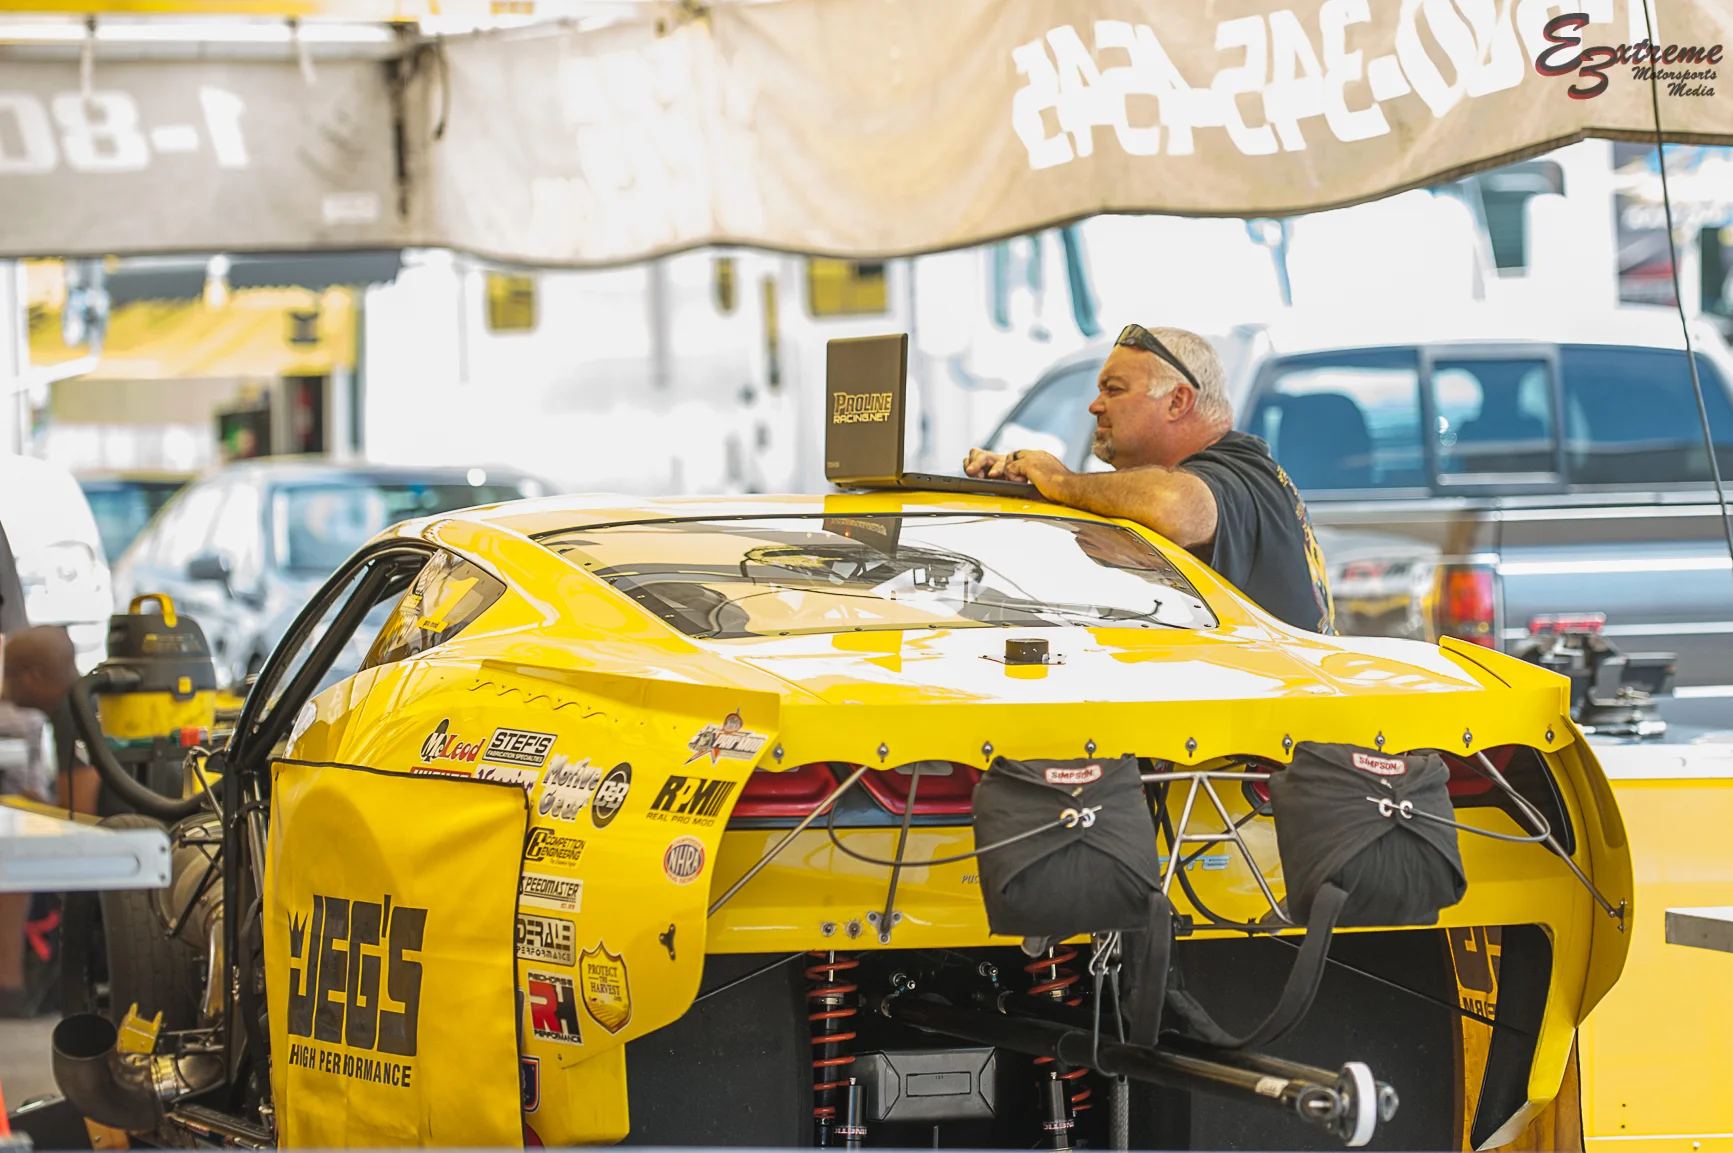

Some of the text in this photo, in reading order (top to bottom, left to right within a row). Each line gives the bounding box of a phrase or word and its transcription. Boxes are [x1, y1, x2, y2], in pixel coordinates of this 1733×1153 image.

[833, 392, 893, 416] PROLINE
[421, 732, 486, 763] McLeod
[491, 731, 553, 755] STEF'S
[542, 754, 602, 791] Motive
[1357, 755, 1398, 771] SIMPSON
[1050, 768, 1094, 782] SIMPSON
[539, 787, 588, 822] Gear
[650, 775, 737, 817] RPM
[646, 813, 715, 827] REAL PRO MOD
[545, 836, 587, 850] COMPETITION
[541, 847, 582, 861] ENGINEERING
[668, 845, 700, 876] NHRA
[587, 963, 618, 978] PROTECT
[590, 982, 620, 996] HARVEST
[534, 1029, 583, 1044] PERFORMANCE
[289, 1043, 316, 1070] HIGH
